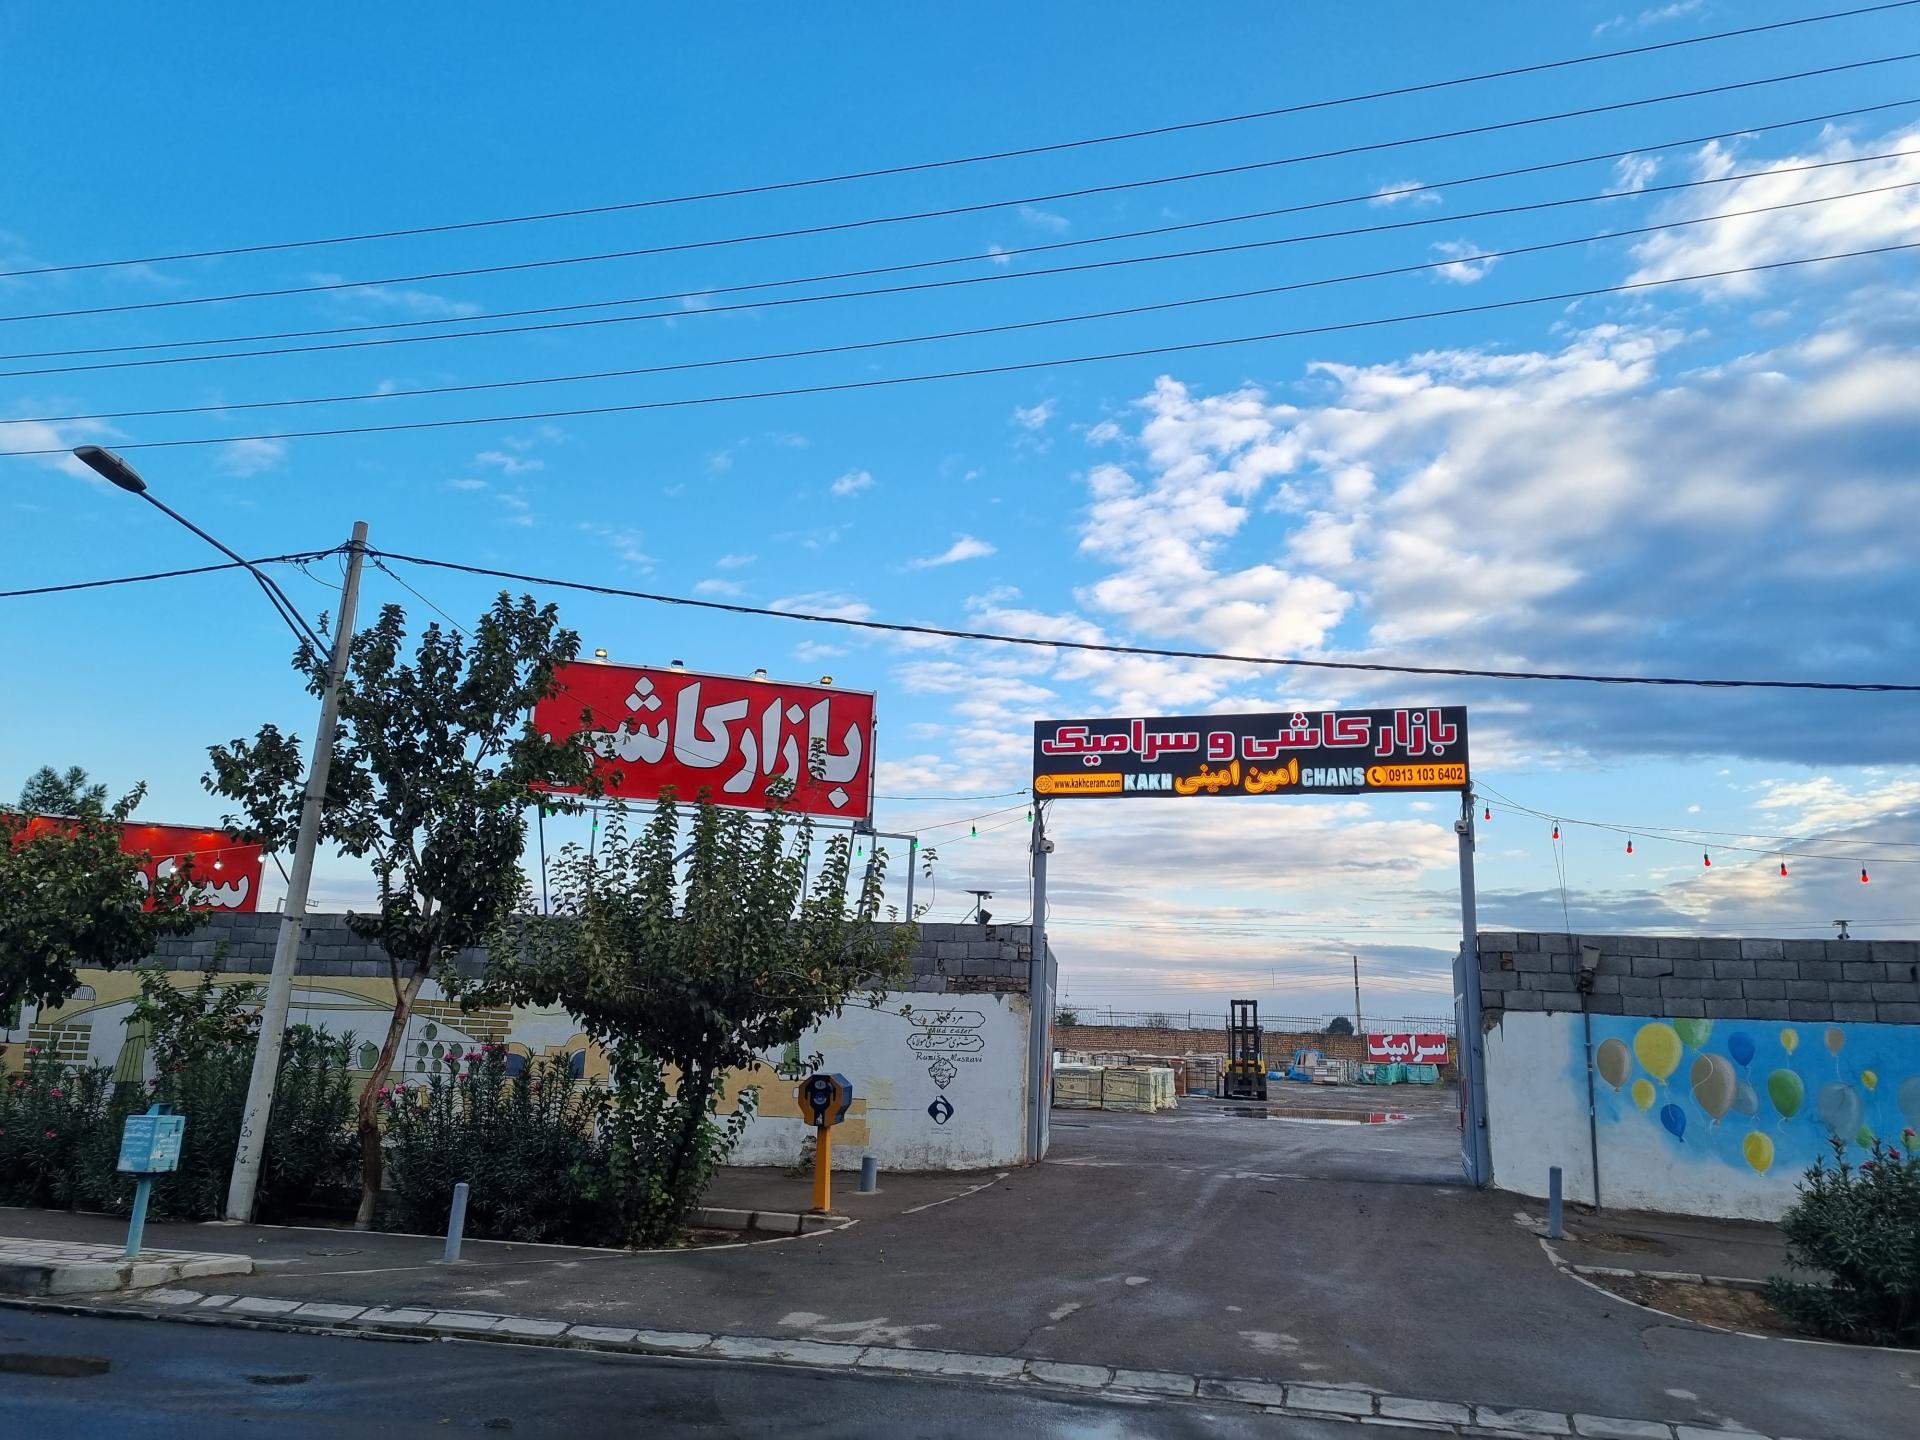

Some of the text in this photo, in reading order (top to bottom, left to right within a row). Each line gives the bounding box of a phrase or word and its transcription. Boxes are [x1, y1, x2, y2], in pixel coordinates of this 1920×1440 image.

[541, 676, 863, 809] بازار کاش
[1041, 708, 1457, 766] بازار کاشی و سرامیک
[1054, 776, 1121, 789] www.kakhceram.com
[1124, 773, 1173, 791] KAKH
[1174, 757, 1299, 795] امین امینی
[1301, 766, 1366, 788] CHANS
[1389, 767, 1463, 782] 0913 103 6402
[1369, 1034, 1446, 1062] سرامیک
